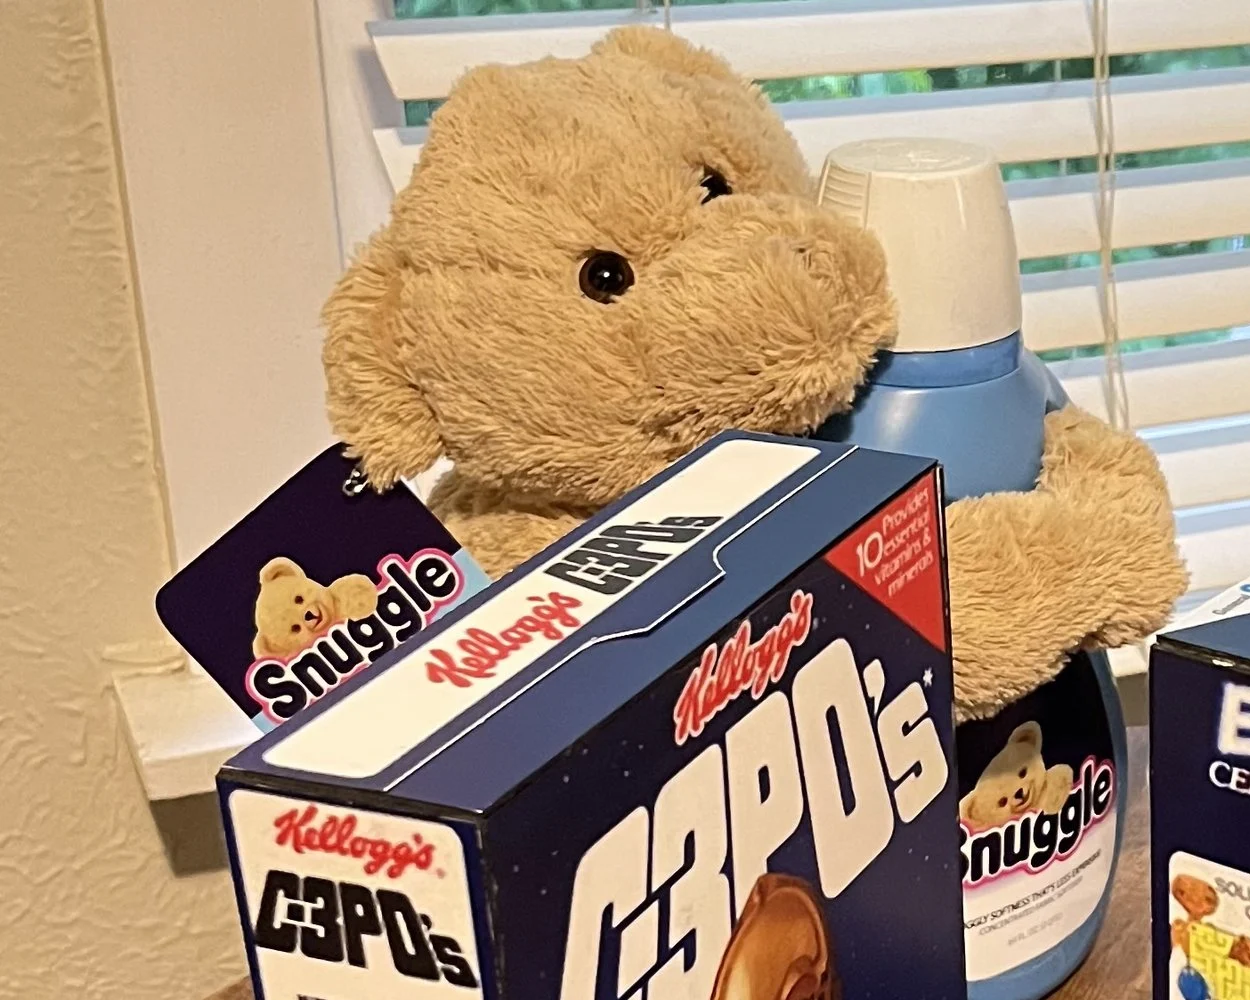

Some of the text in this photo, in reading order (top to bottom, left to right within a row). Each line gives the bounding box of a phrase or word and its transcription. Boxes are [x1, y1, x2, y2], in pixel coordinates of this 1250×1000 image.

[856, 504, 930, 577] 10 essential
[883, 488, 928, 536] Provides
[874, 539, 921, 585] vitamins
[888, 550, 933, 596] minerals
[254, 556, 458, 714] Snuggle
[425, 591, 582, 688] Kellogg's
[675, 590, 814, 745] Kellogg's
[275, 803, 435, 879] Kellogg's
